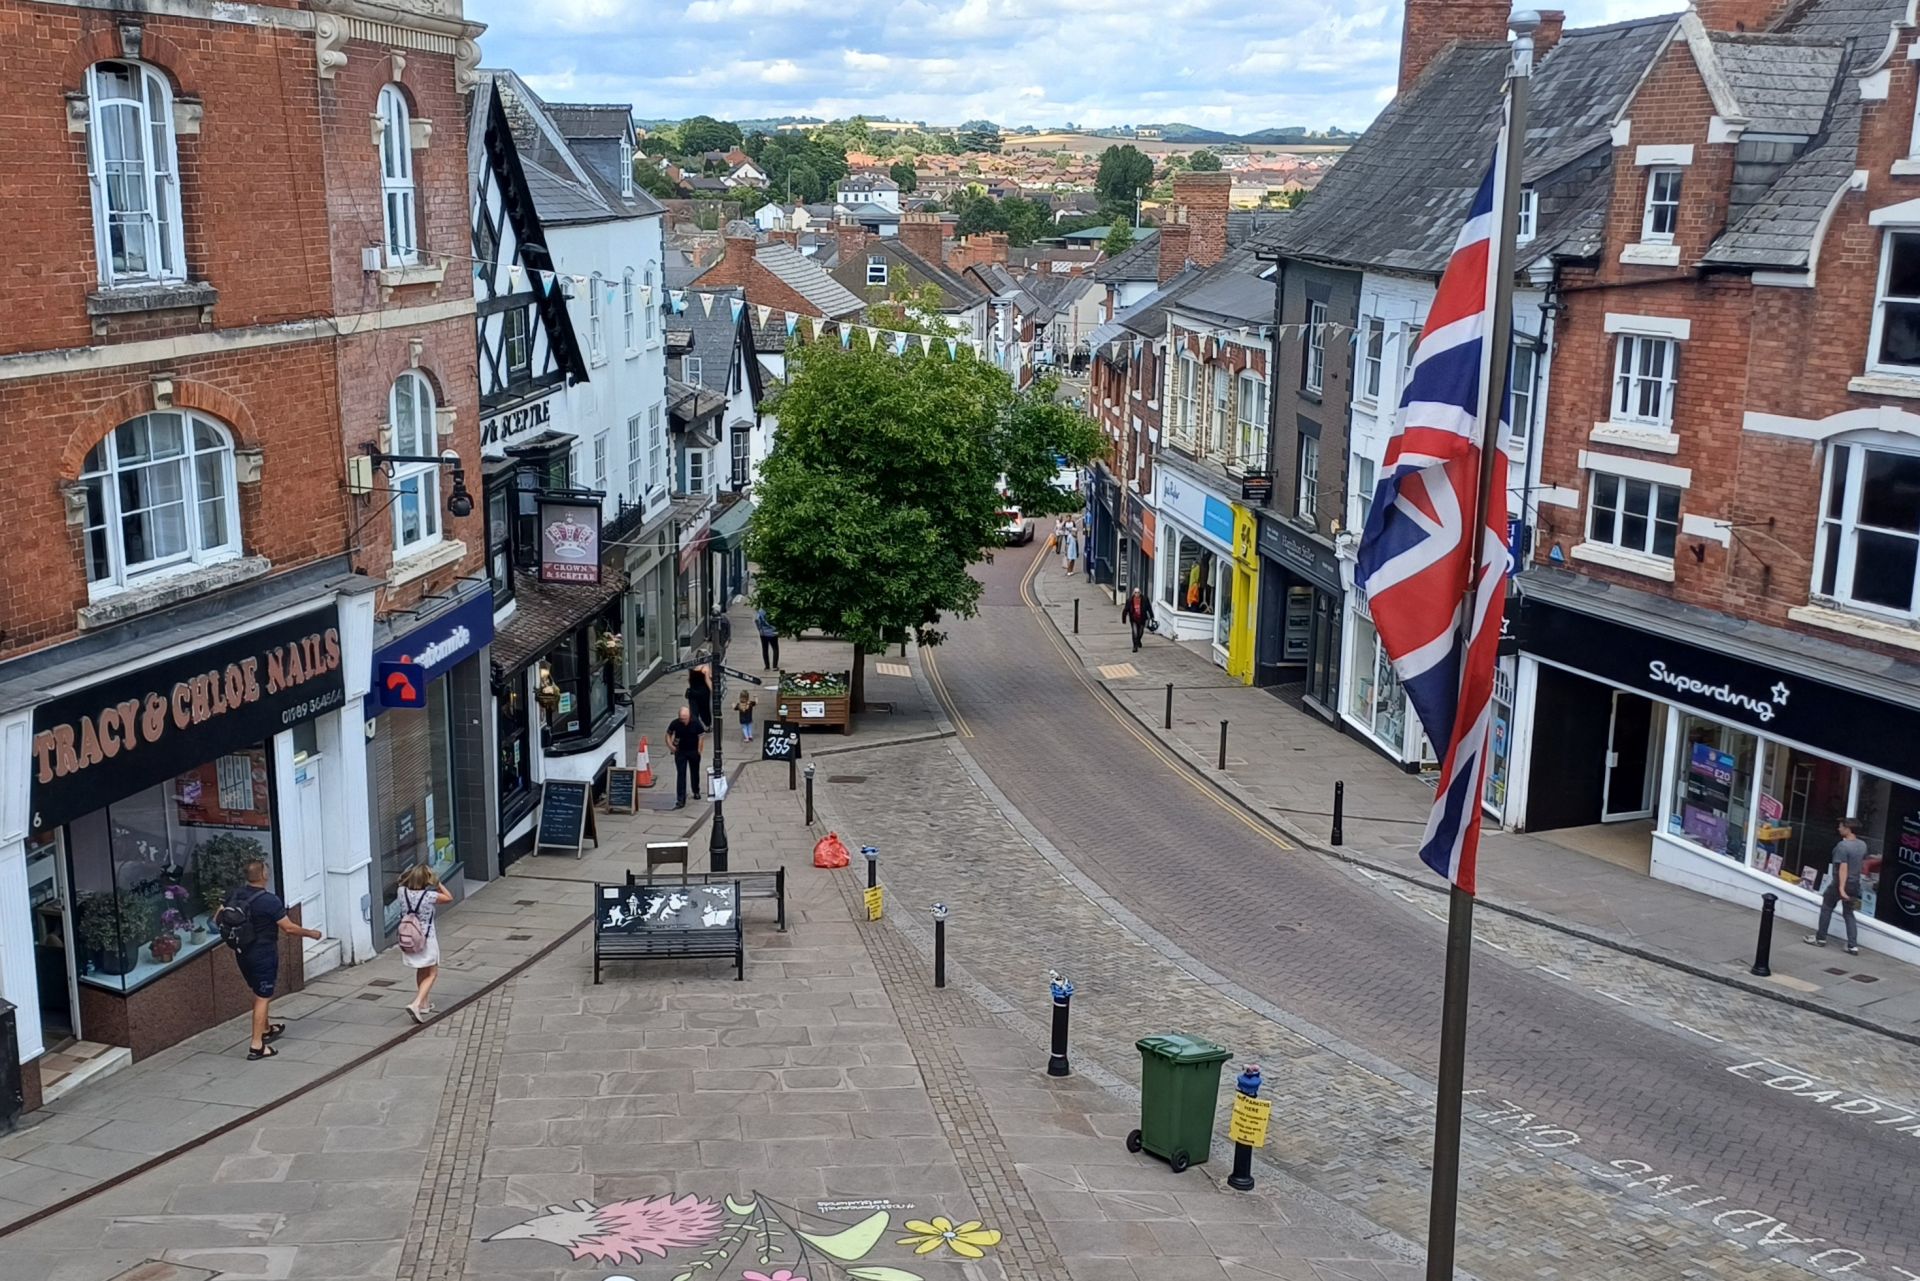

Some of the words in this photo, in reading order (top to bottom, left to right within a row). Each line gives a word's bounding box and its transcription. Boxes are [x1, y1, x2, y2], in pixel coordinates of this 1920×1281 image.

[500, 400, 550, 439] SCEPTRE
[553, 563, 587, 572] CROWN
[555, 572, 595, 581] SCEPTRE
[1649, 660, 1775, 721] Superdrug
[32, 699, 139, 784] TRACY
[142, 692, 167, 742] &
[172, 656, 260, 729] CHLOE
[266, 628, 340, 695] NAILS
[33, 811, 41, 828] 6
[1244, 1105, 1259, 1114] HERE
[1245, 1098, 1270, 1108] PARKING
